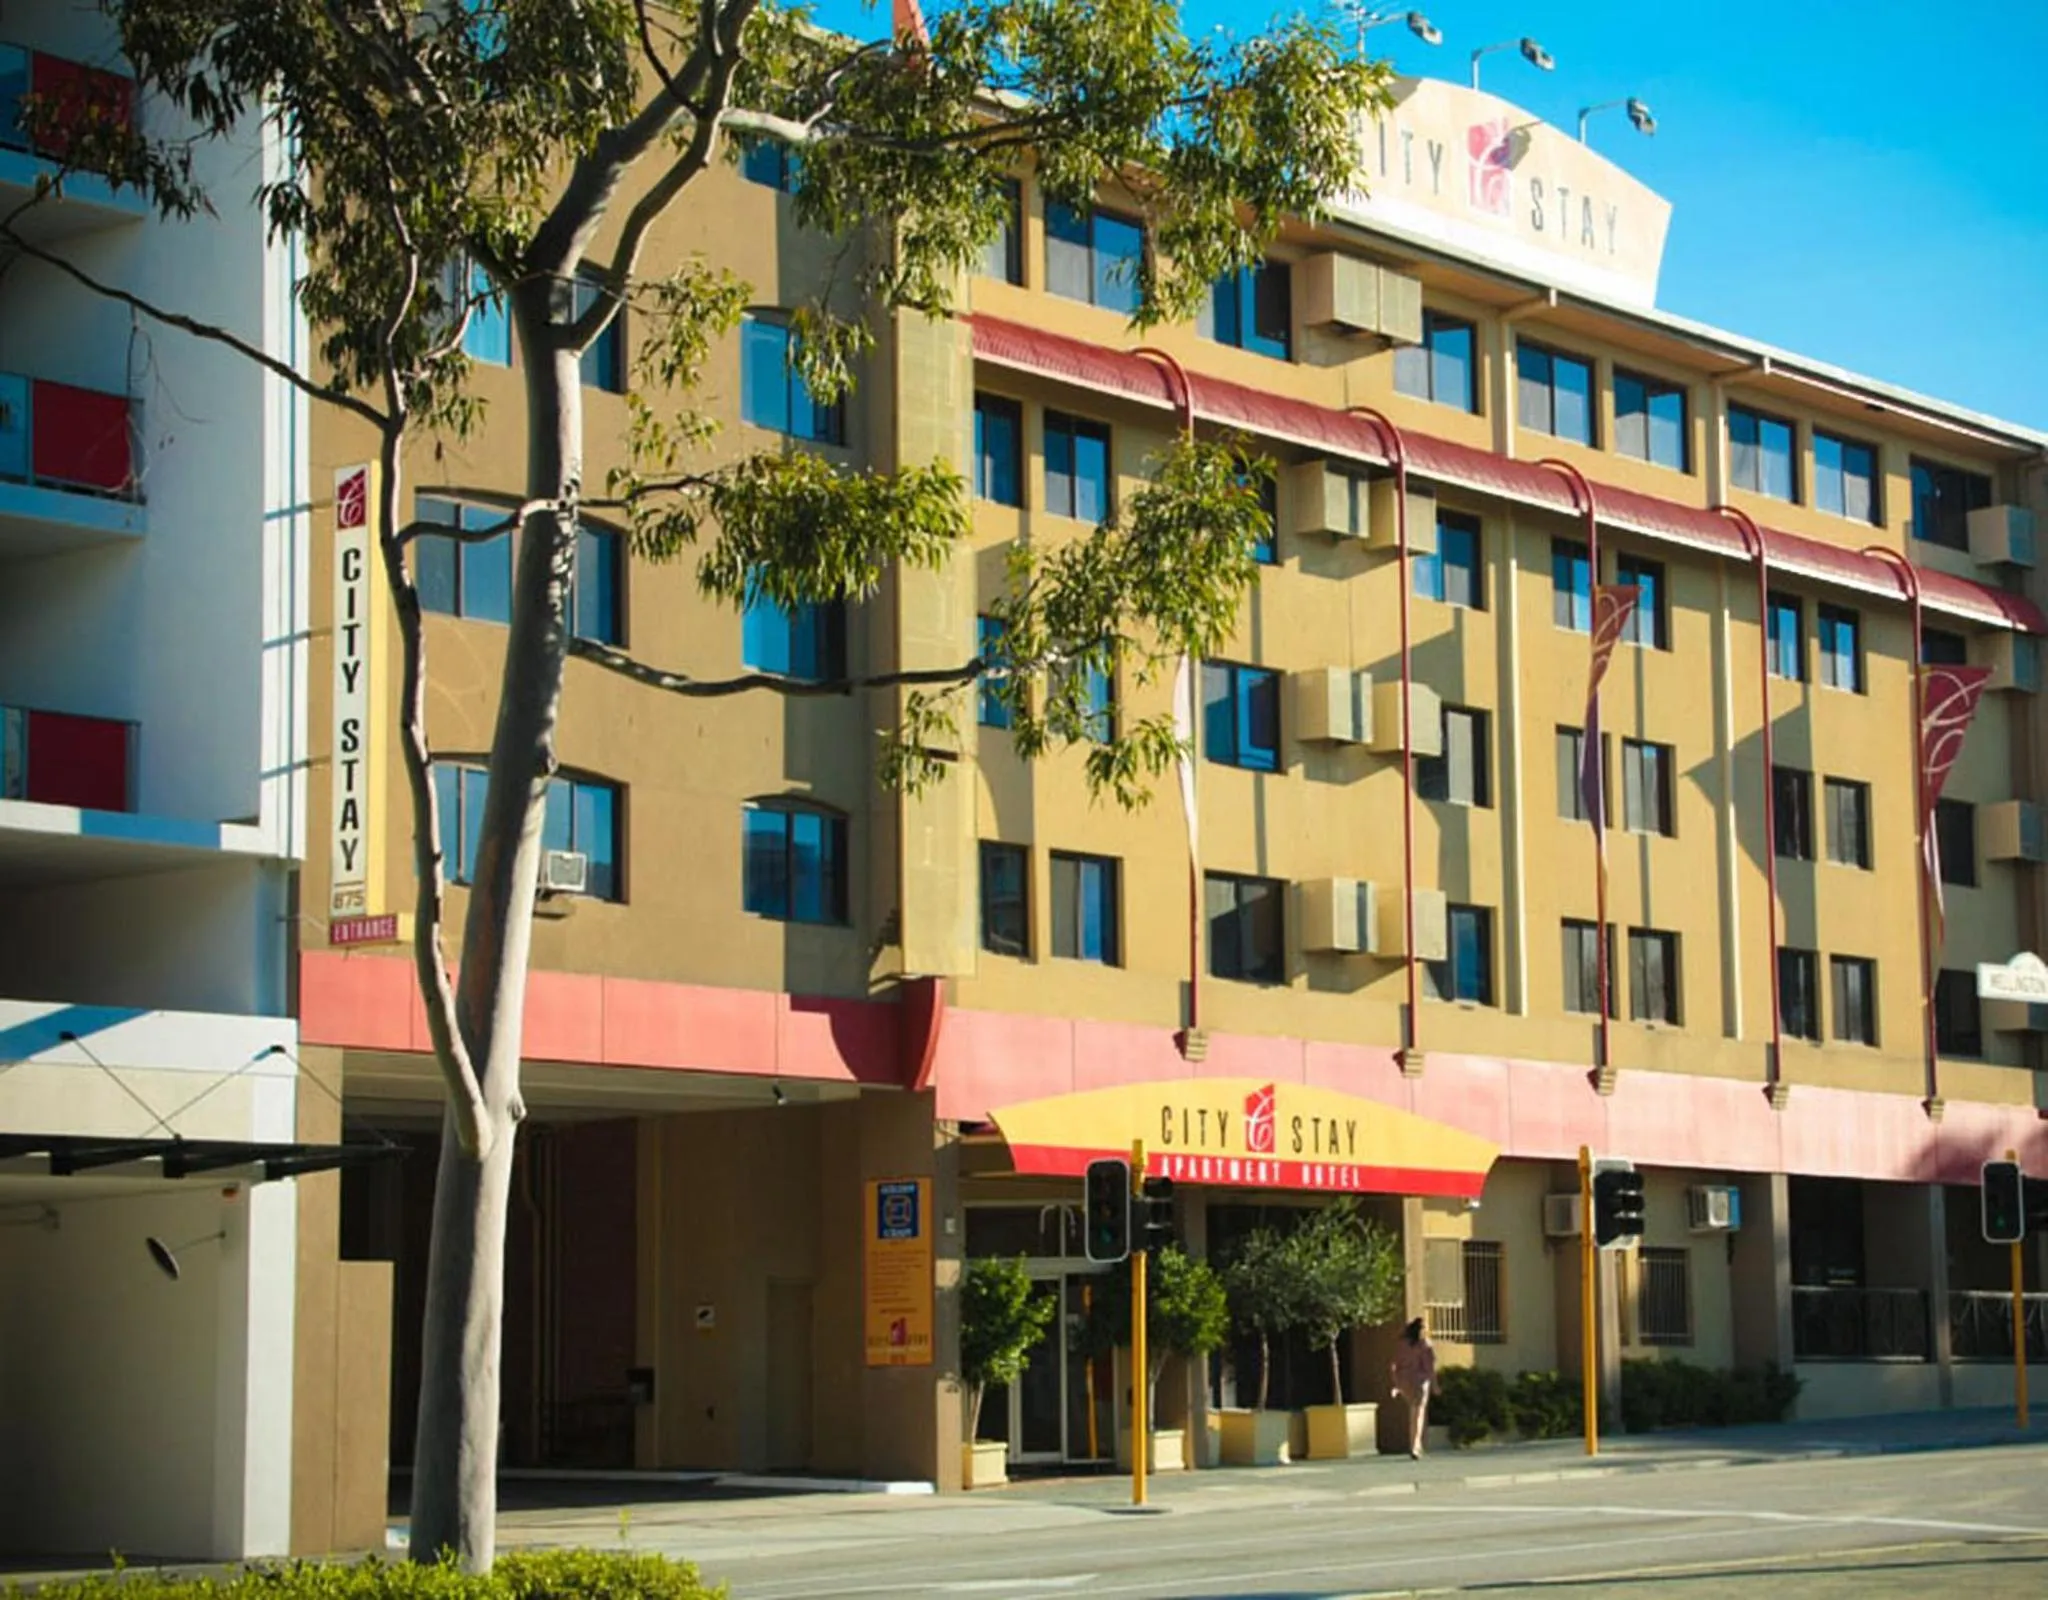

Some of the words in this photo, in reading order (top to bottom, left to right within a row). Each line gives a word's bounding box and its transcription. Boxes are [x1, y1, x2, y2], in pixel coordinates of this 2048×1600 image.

[1529, 176, 1618, 255] STAY
[341, 547, 361, 694] CITY
[339, 717, 360, 873] STAY
[333, 916, 394, 943] ENTRANCE
[1160, 1104, 1229, 1148] CITY
[1290, 1114, 1359, 1156] STAY
[1160, 1154, 1281, 1182] APARTMENT
[1301, 1163, 1361, 1188] HOTEL
